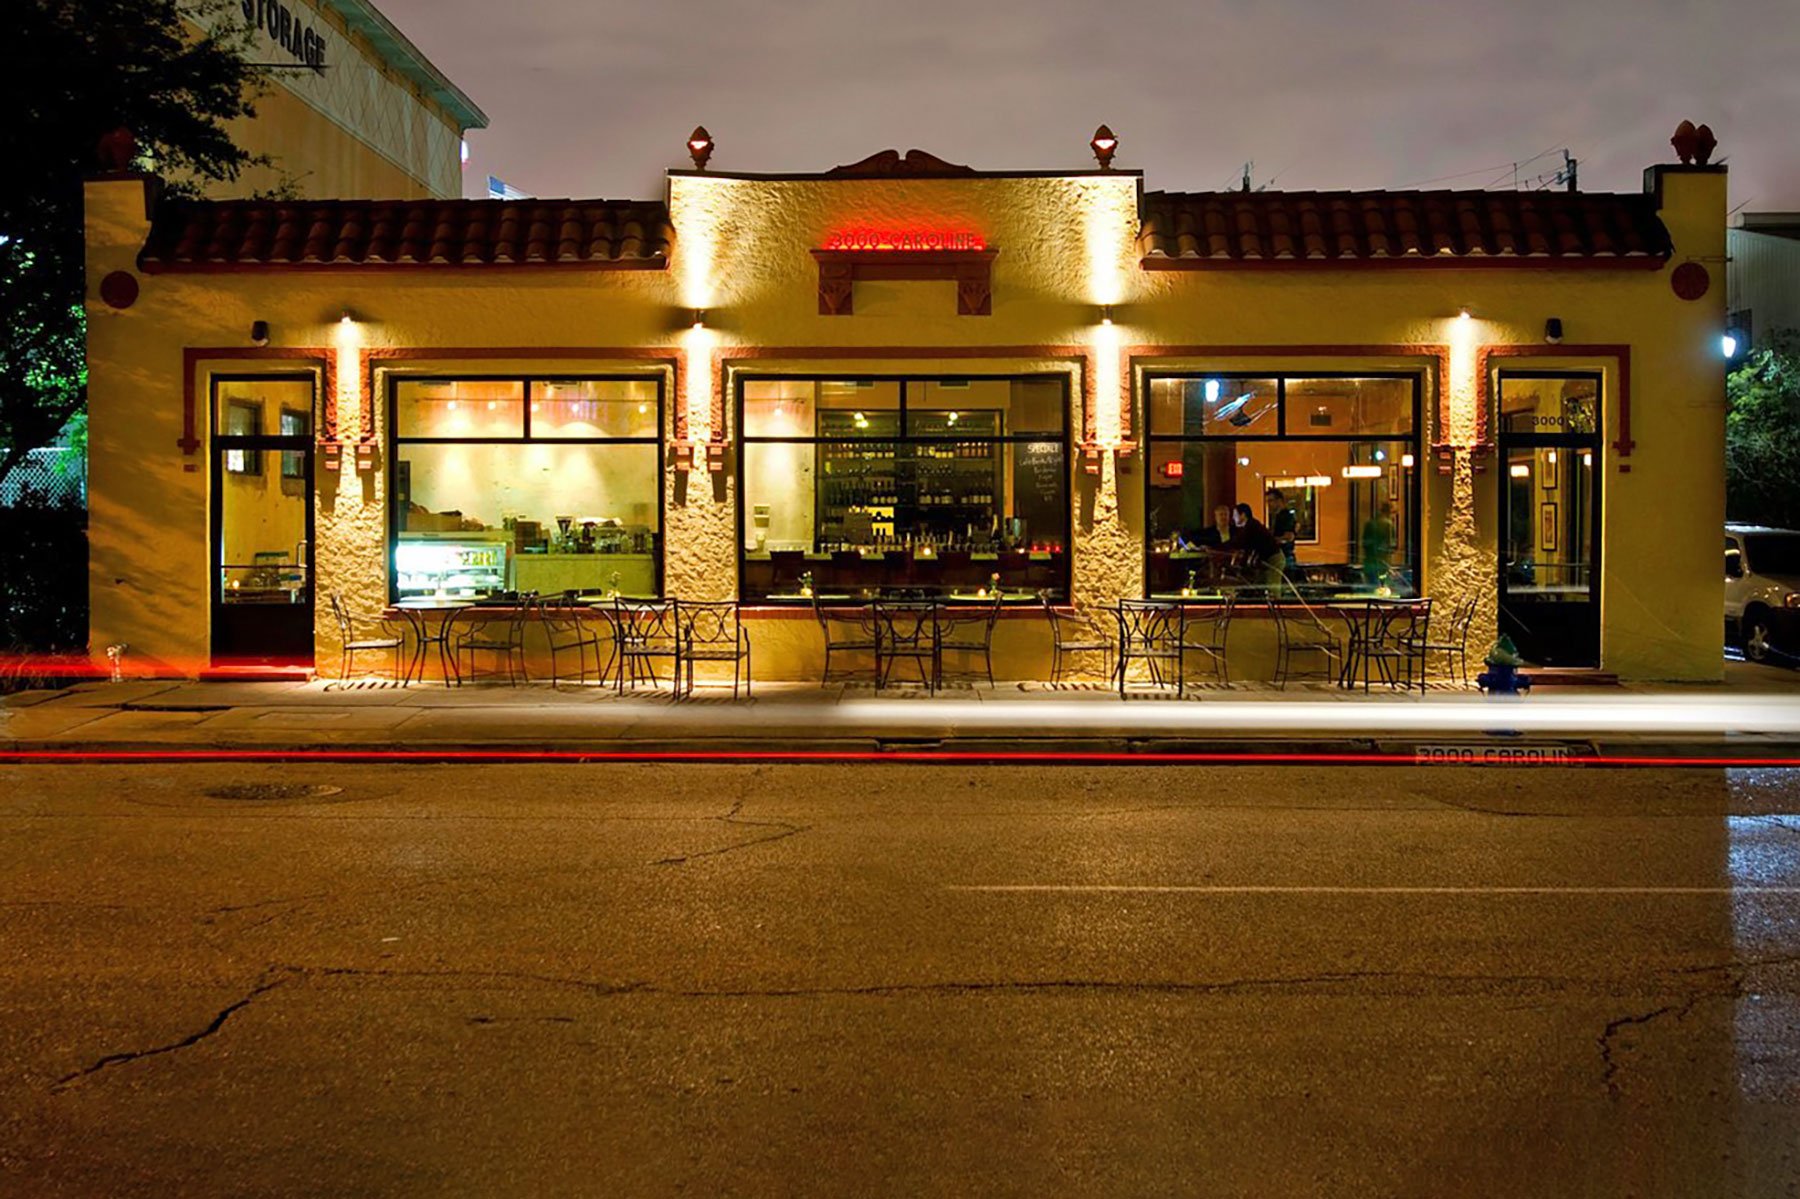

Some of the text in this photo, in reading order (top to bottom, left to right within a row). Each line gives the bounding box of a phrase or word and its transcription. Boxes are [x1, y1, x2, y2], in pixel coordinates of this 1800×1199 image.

[831, 233, 976, 248] 3000 CAROLINE
[1531, 415, 1565, 426] 3000
[1418, 747, 1570, 765] 3000 CAROLIN
